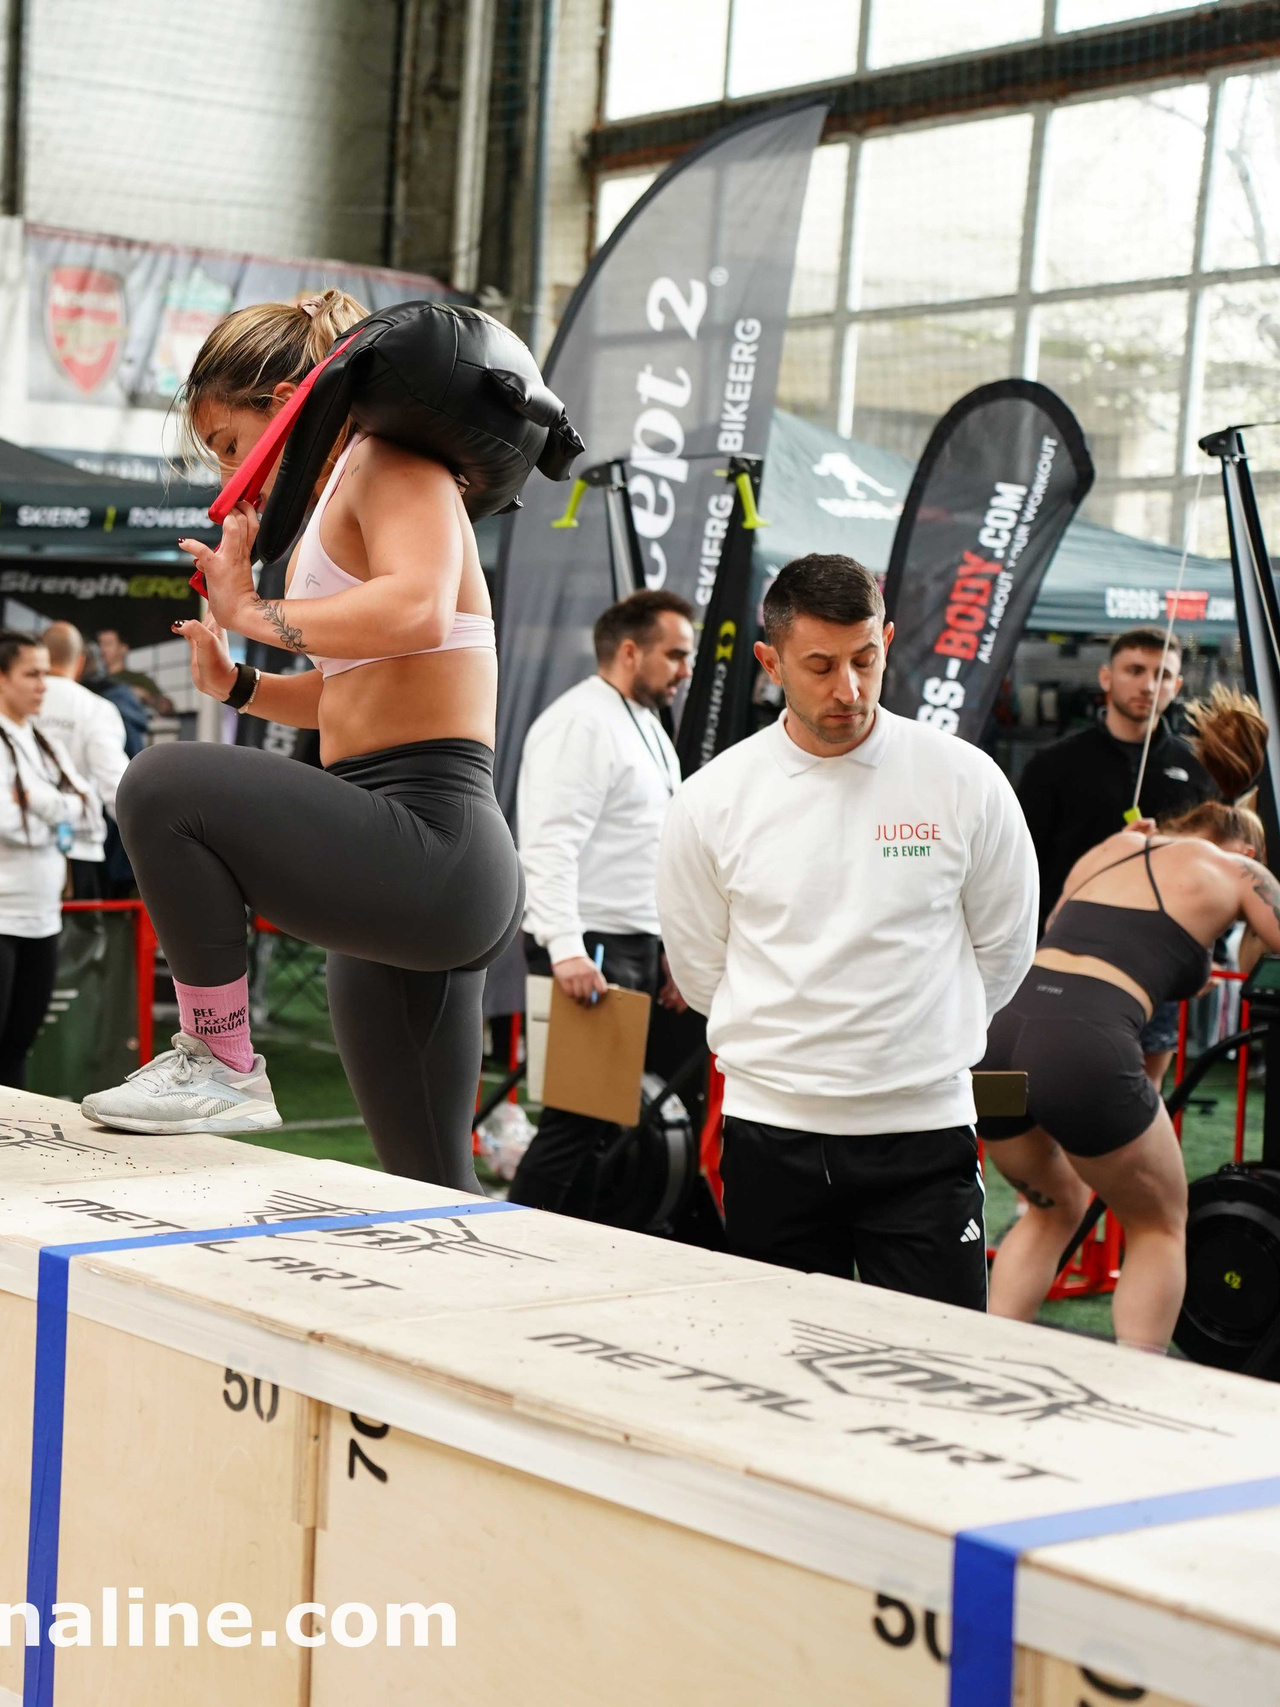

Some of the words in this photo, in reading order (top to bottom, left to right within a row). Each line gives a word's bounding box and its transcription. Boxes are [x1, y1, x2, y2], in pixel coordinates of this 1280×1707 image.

[647, 275, 709, 341] 2
[717, 317, 762, 452] BIKEERG
[1020, 434, 1059, 524] WORKOUT
[17, 504, 90, 529] SKIERG
[992, 571, 1015, 630] ABOUT
[976, 630, 1000, 665] ALL
[875, 822, 942, 841] JUDGE
[883, 846, 899, 857] IF3
[901, 845, 932, 857] EVENT
[192, 1008, 217, 1018] BEE
[195, 1016, 247, 1036] UNUSUAL
[42, 1197, 241, 1255] METL
[246, 1255, 405, 1291] ART
[222, 1367, 279, 1424] 50
[527, 1331, 820, 1424] METAL
[842, 1423, 1085, 1485] ART
